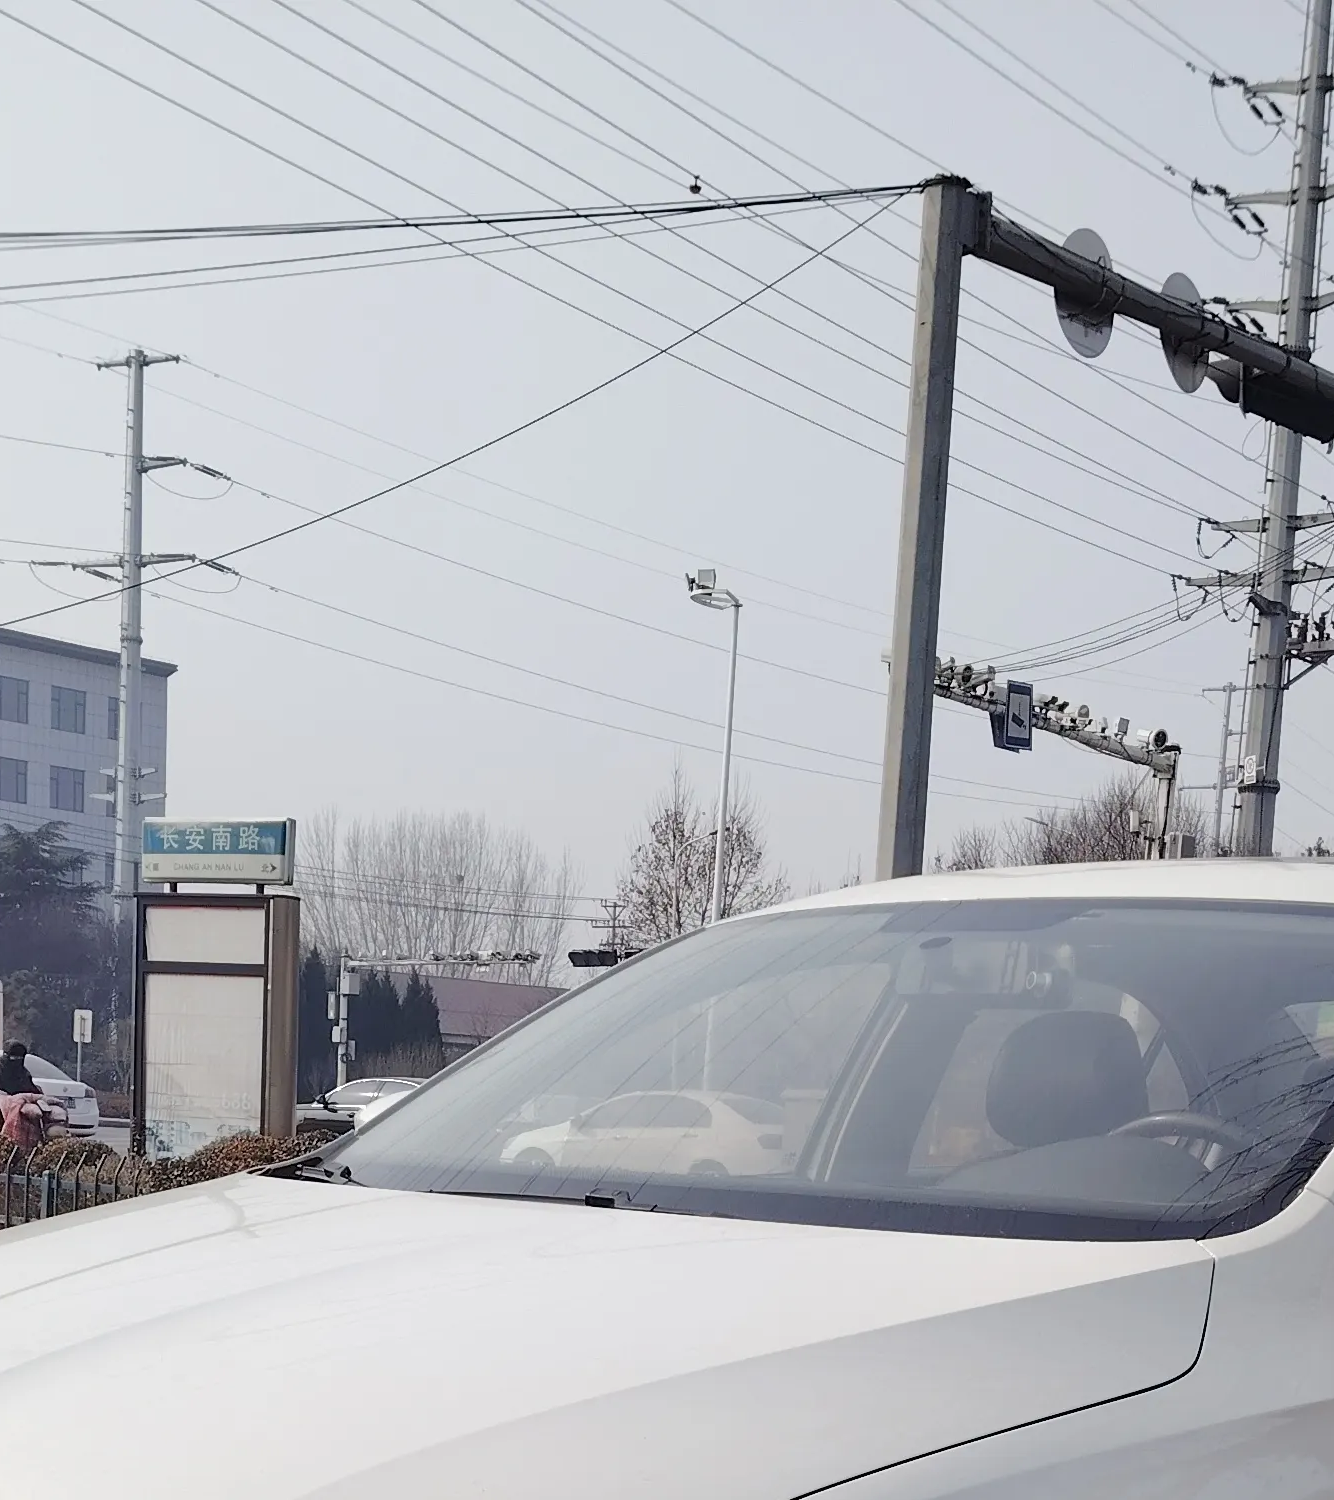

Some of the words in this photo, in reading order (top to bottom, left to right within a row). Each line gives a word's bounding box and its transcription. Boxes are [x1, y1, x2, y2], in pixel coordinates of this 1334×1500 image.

[159, 824, 261, 851] 长安南路
[173, 862, 199, 871] CHANG
[201, 862, 212, 871] AN
[215, 862, 231, 871] NAN
[234, 863, 244, 871] LU
